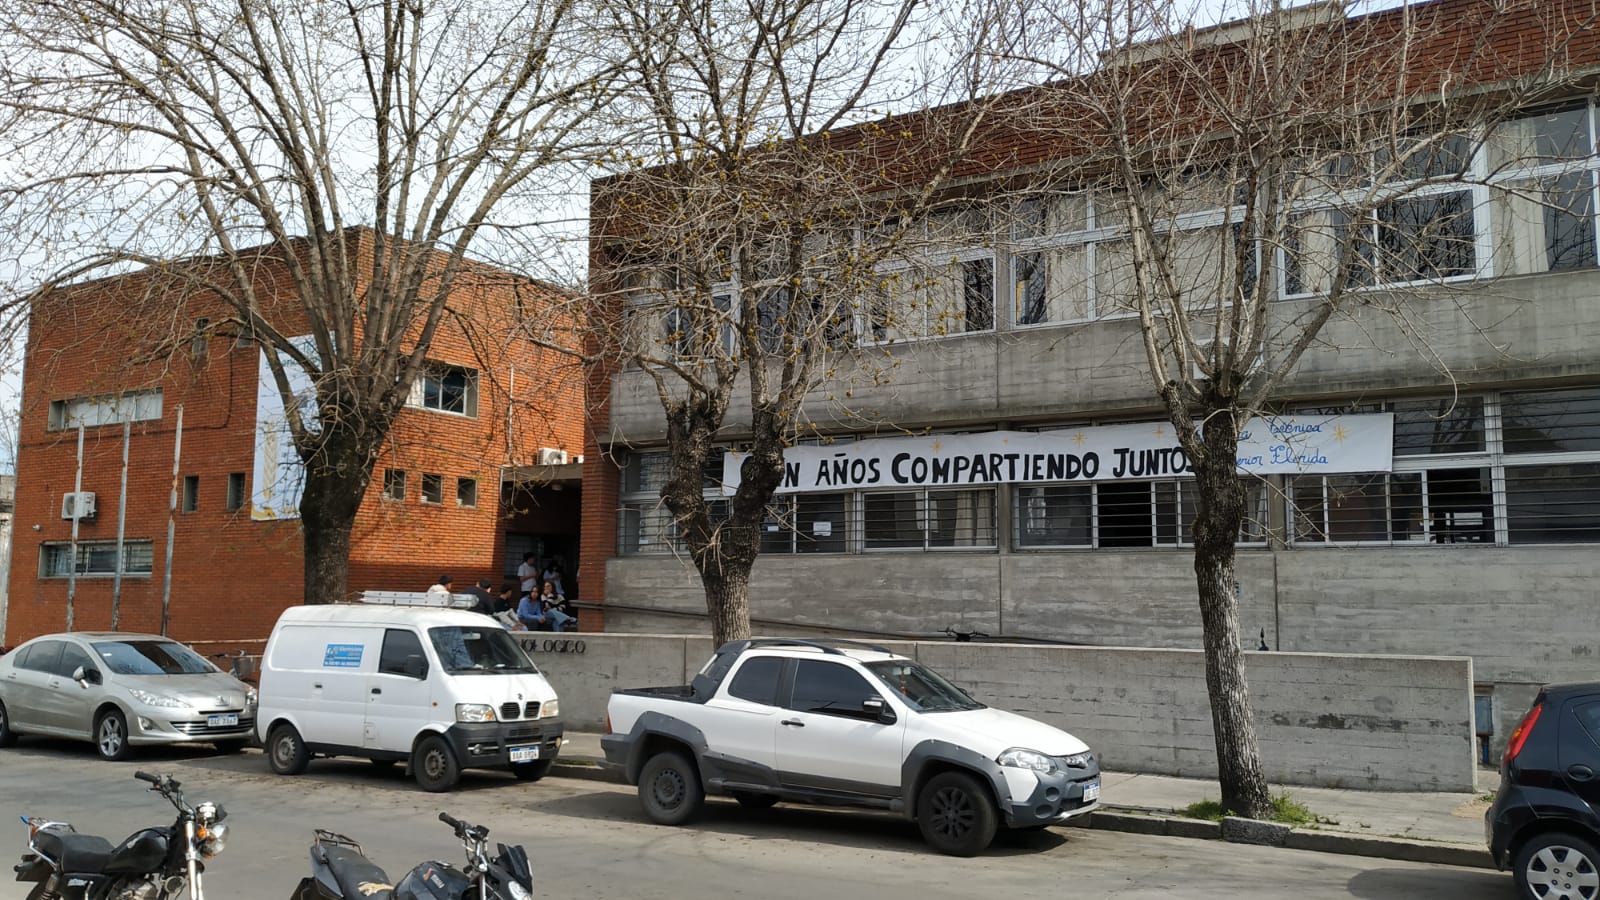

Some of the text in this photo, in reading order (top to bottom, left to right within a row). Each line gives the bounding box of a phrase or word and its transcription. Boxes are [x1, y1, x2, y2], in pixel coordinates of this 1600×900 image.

[815, 453, 880, 486] AÑOS
[891, 452, 1100, 484] COMPARTIENDO
[1112, 446, 1195, 478] JUNTO
[1269, 444, 1329, 465] Florida
